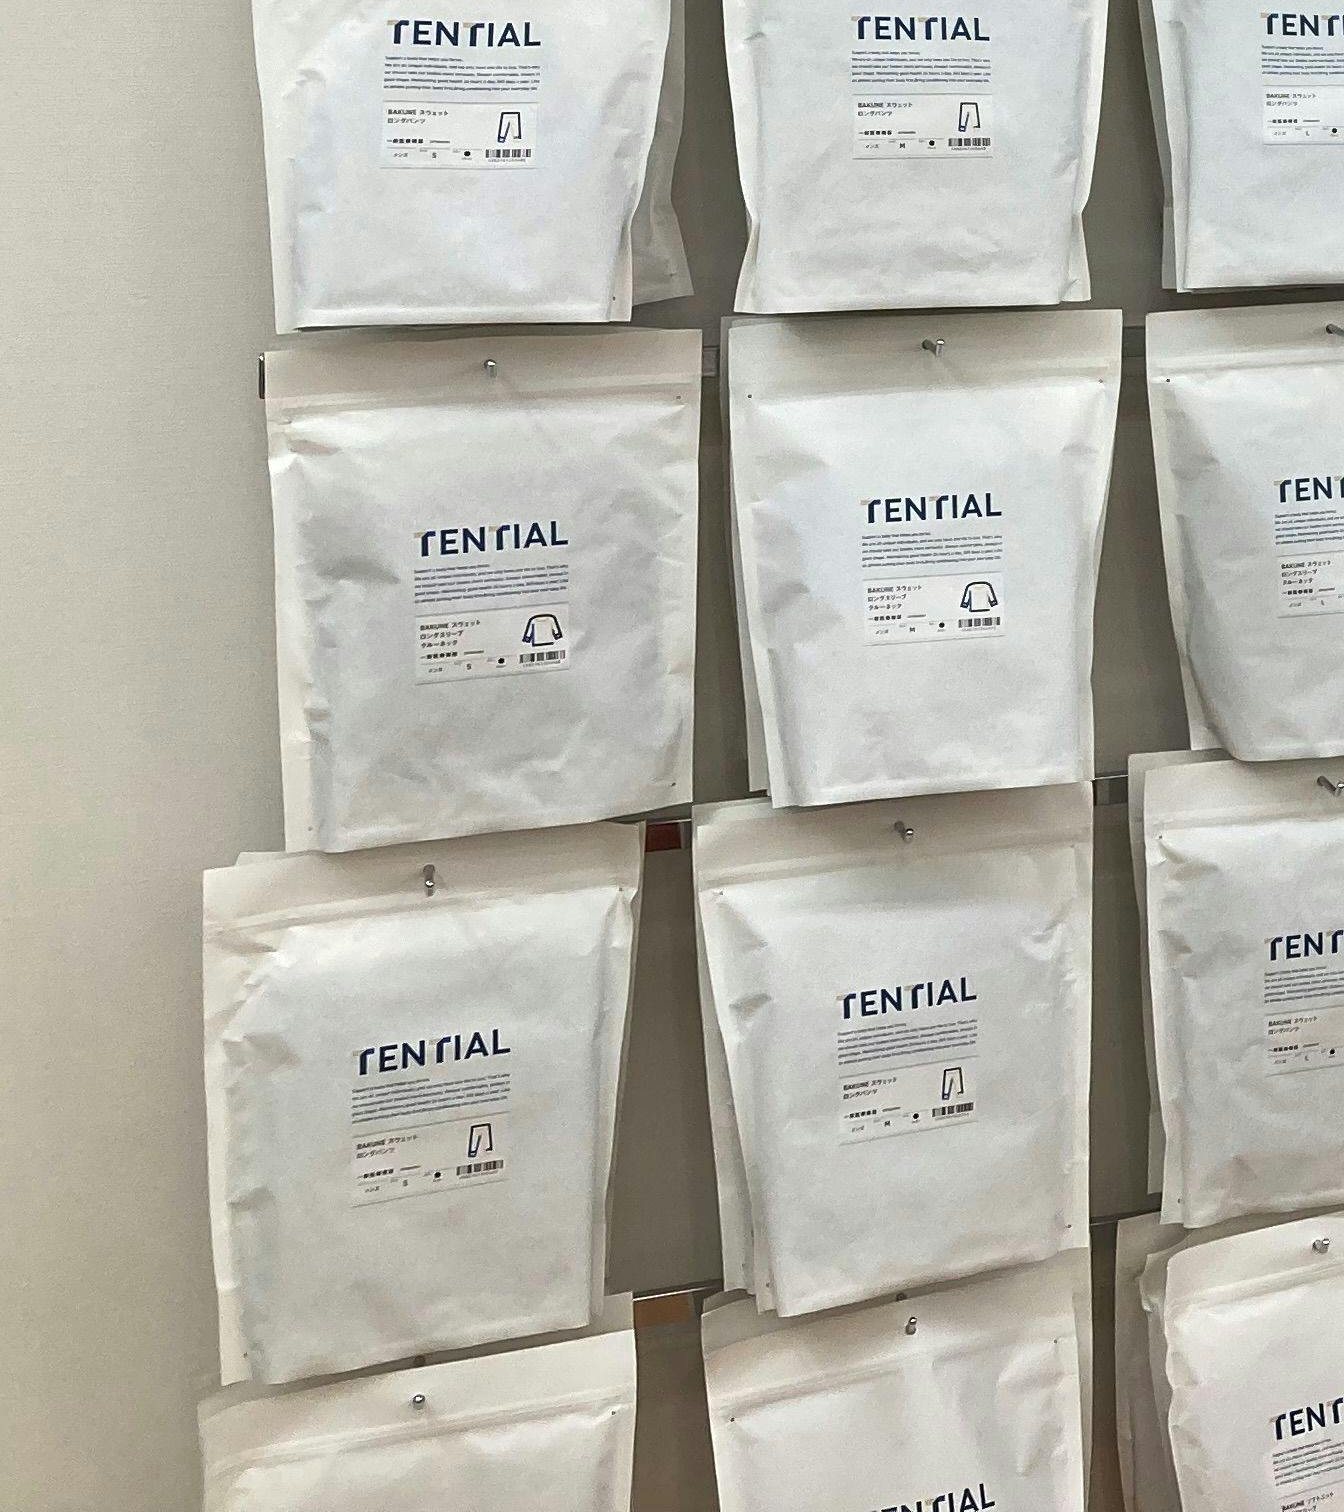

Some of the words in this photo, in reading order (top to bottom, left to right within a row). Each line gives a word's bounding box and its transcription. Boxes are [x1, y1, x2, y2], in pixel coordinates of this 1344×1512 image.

[386, 20, 540, 46] TENTIAL
[851, 17, 989, 41] TENTIAL
[861, 493, 1001, 523] TENTIAL
[414, 521, 568, 557] TENTIAL
[837, 978, 976, 1019] TENTIAL
[352, 1029, 510, 1075] TENTIAL
